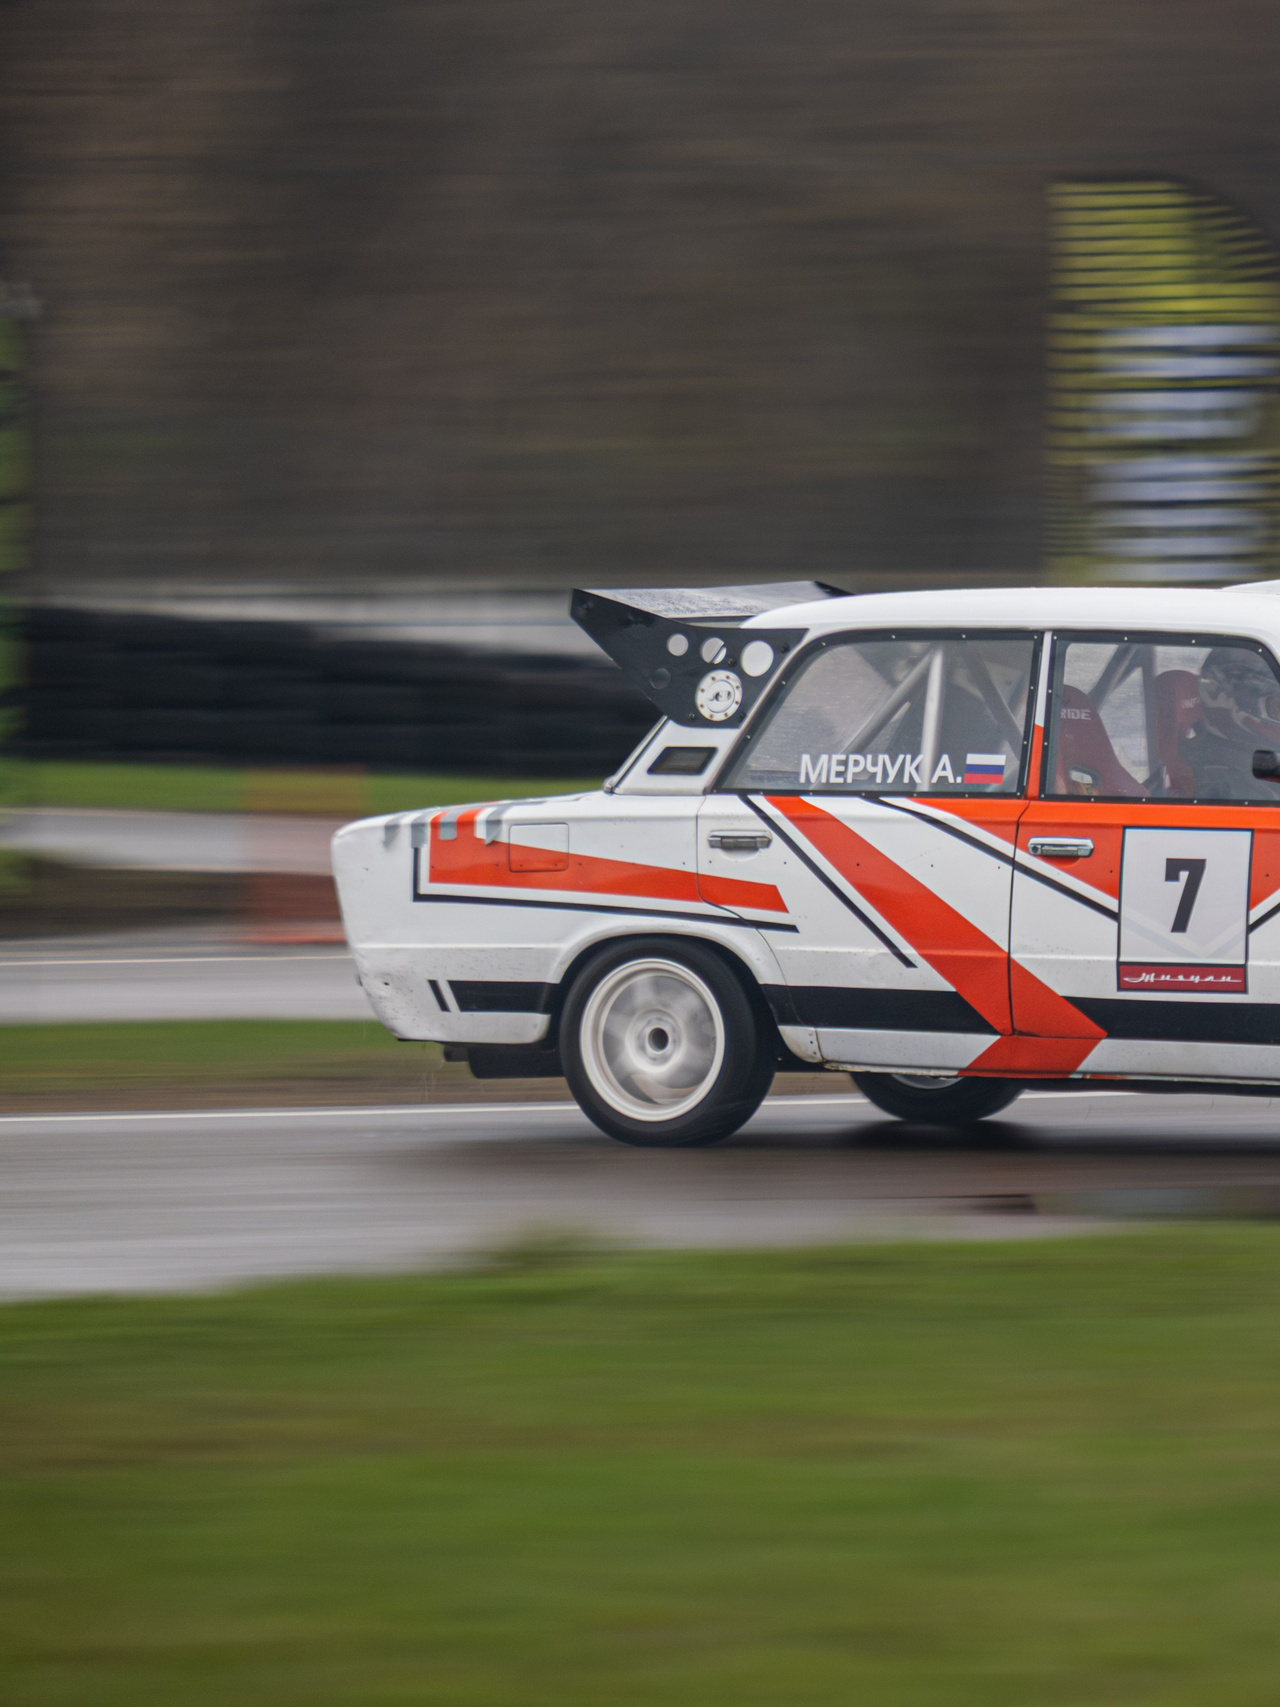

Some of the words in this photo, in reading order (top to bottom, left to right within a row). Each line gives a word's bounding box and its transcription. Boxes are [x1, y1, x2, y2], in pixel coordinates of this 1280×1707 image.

[799, 753, 924, 784] МЕРЧУК
[931, 753, 962, 784] А.
[1164, 857, 1207, 934] 7
